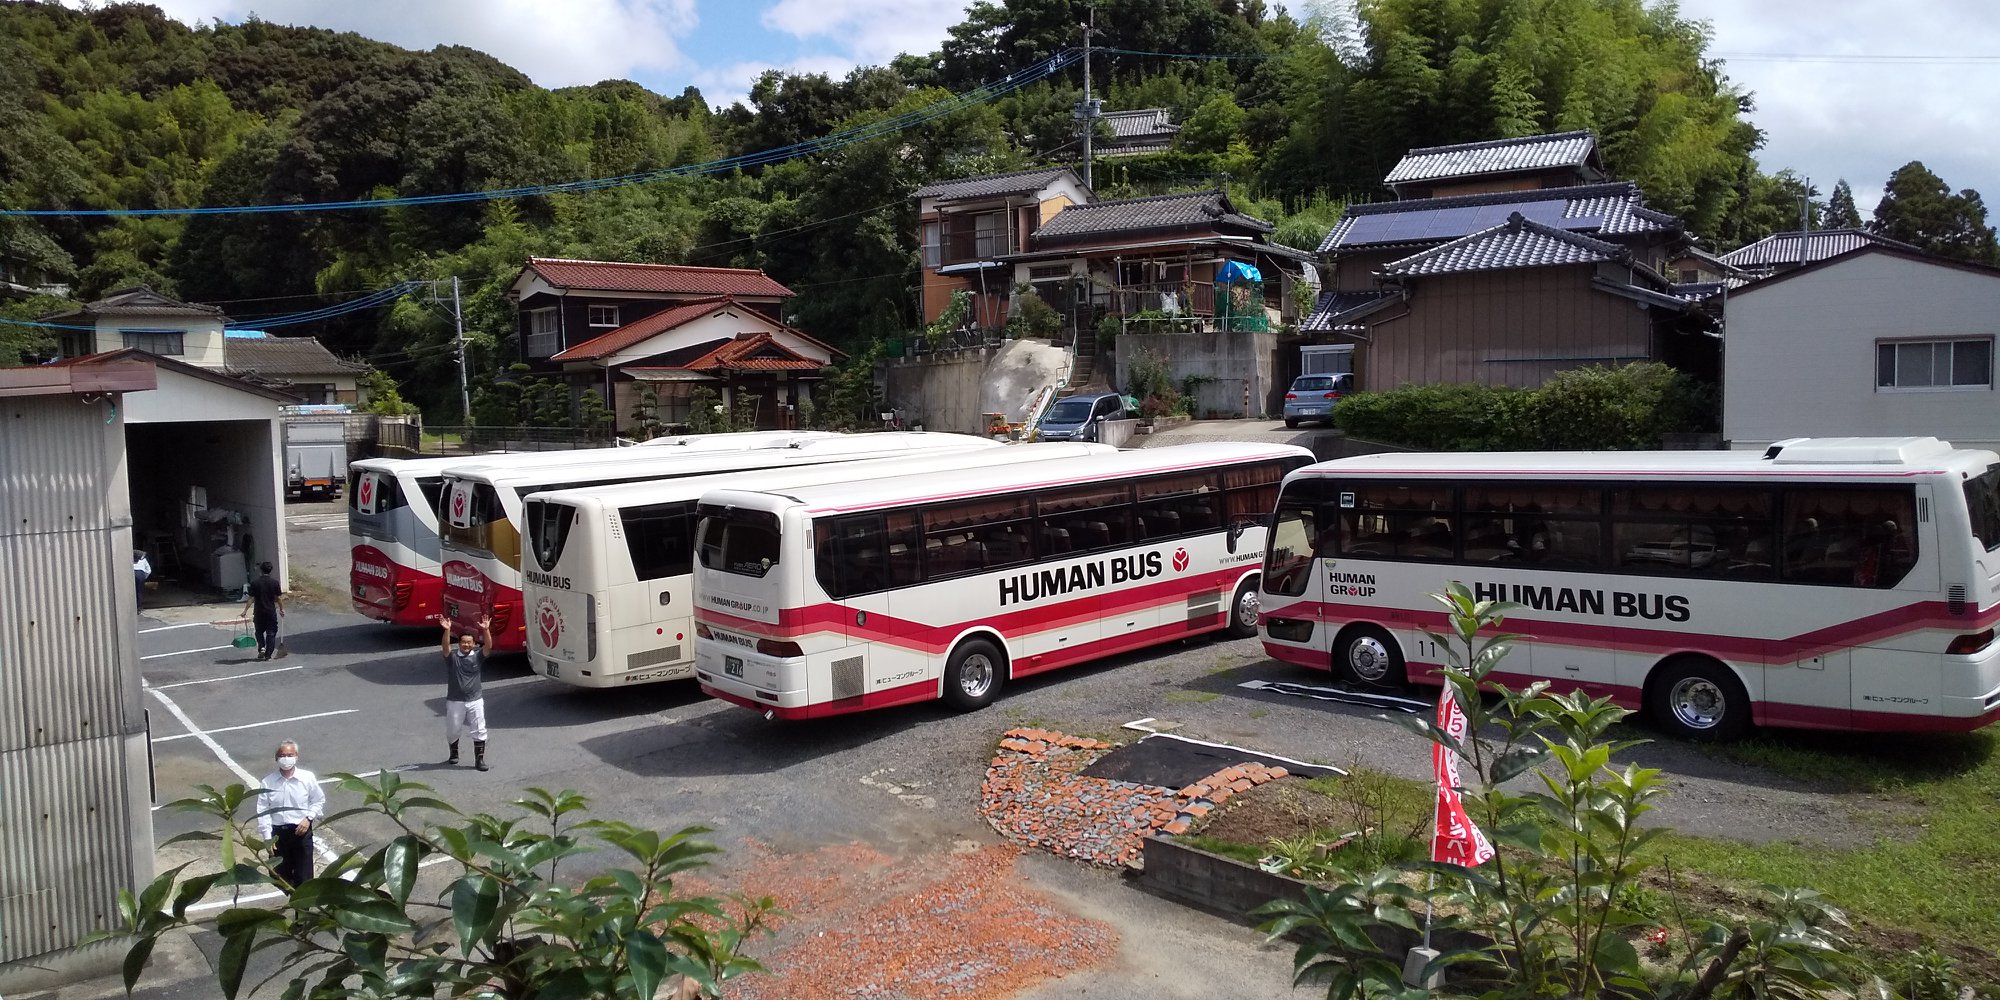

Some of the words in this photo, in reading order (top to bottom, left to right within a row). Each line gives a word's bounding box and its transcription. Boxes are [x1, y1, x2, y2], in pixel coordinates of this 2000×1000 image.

[355, 561, 375, 575] HUMAN
[374, 565, 388, 579] BUS
[999, 560, 1106, 607] HUMAN
[1111, 551, 1163, 584] BUS
[1329, 572, 1376, 585] HUMAN
[446, 573, 469, 589] HUMAN
[469, 579, 484, 593] BUS
[526, 570, 552, 587] HUMAN
[552, 576, 571, 590] BUS
[1330, 584, 1376, 597] GROUP
[1475, 582, 1605, 615] HUMAN
[1613, 591, 1691, 622] BUS
[713, 630, 738, 645] HUMAN
[738, 637, 754, 649] BUS
[1418, 640, 1436, 658] 11
